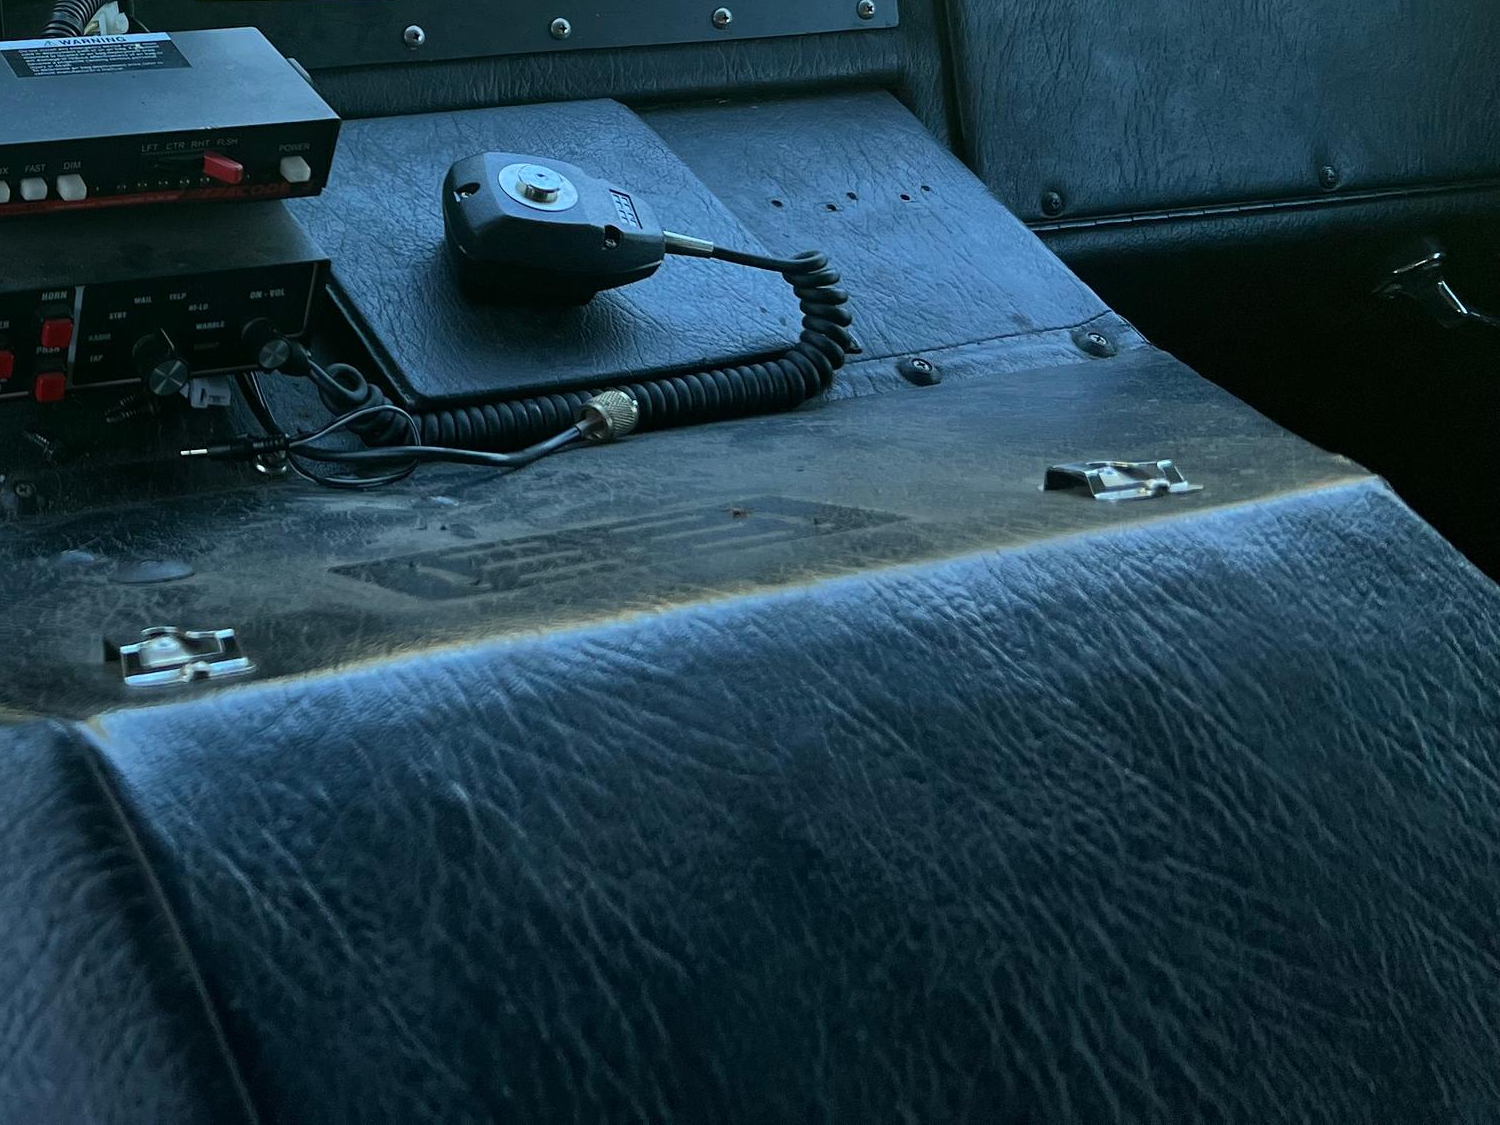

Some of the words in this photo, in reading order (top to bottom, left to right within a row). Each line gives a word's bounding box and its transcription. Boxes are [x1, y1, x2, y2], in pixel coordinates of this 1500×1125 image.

[58, 36, 127, 46] WARNING
[141, 143, 159, 152] LFT
[166, 141, 185, 150] CTR
[278, 143, 311, 152] POWER
[24, 163, 47, 173] FAST
[63, 161, 82, 171] DIM
[41, 291, 67, 301] HORN
[134, 296, 152, 304] WAIL
